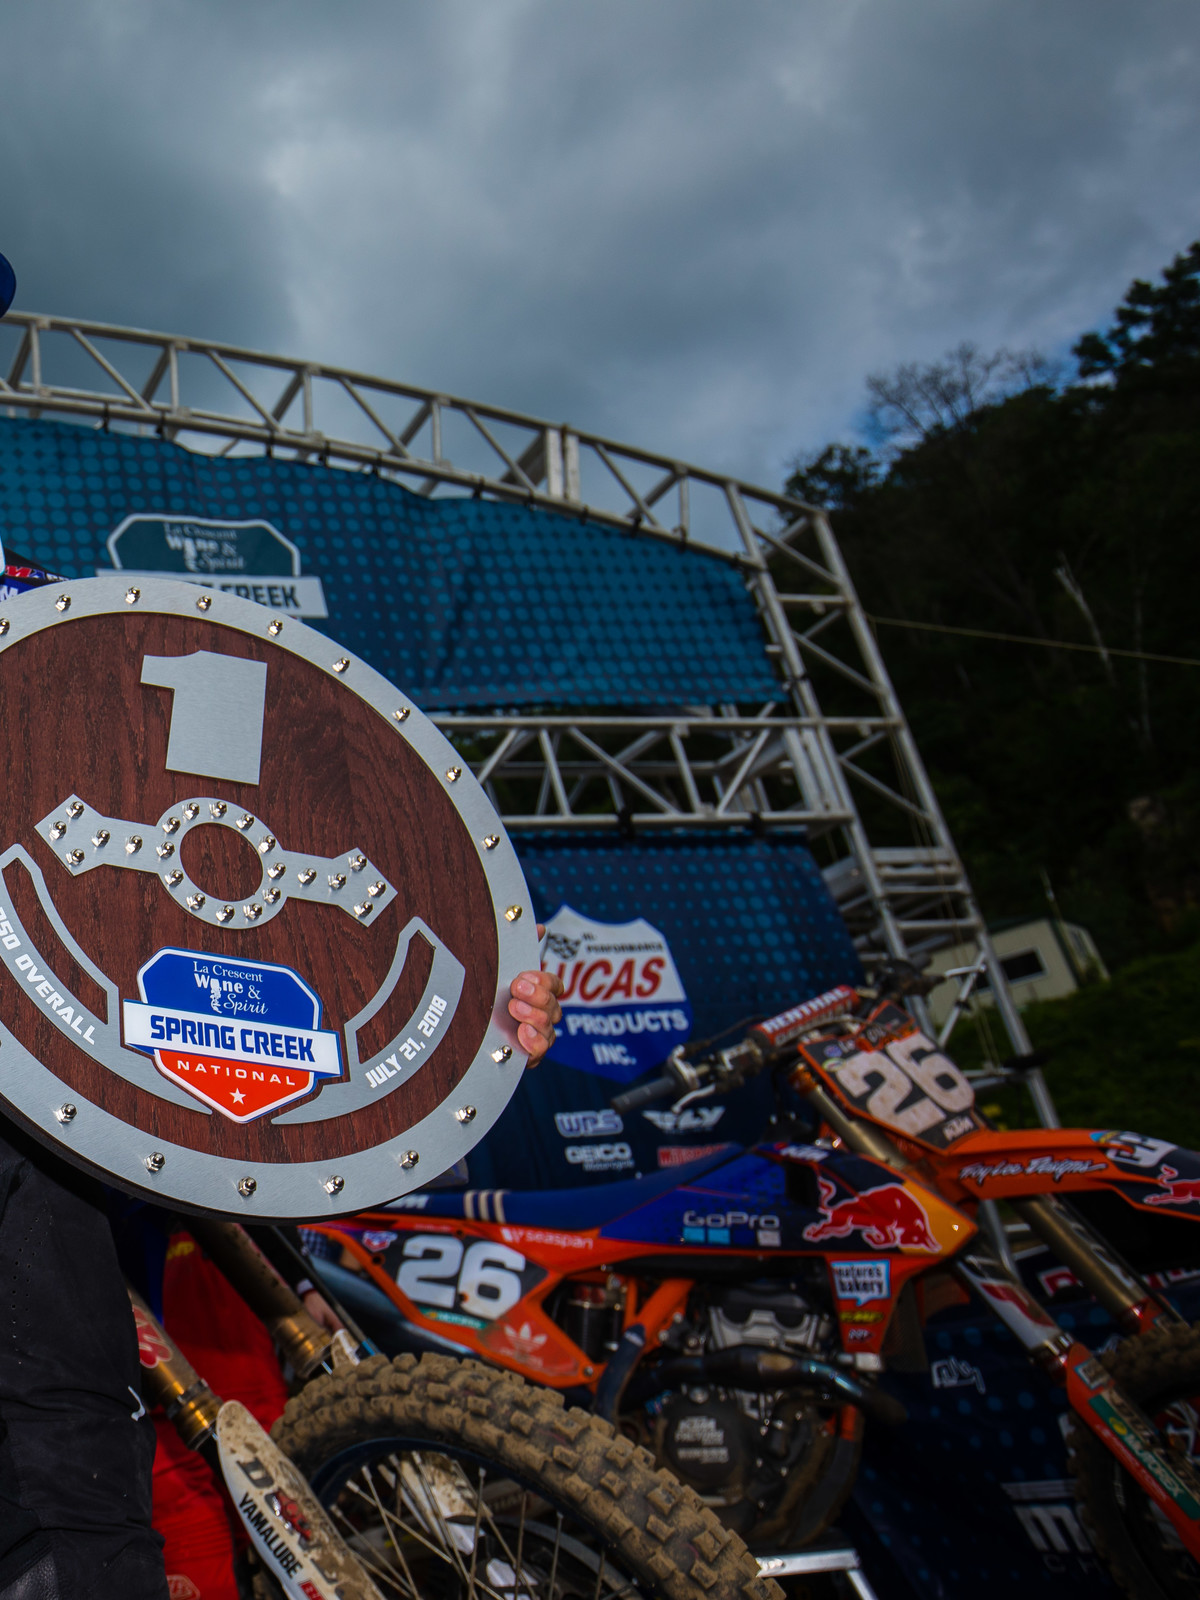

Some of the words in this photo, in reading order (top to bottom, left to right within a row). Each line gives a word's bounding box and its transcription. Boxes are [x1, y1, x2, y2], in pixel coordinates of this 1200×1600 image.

[140, 650, 267, 786] 1
[193, 961, 209, 974] La
[212, 964, 263, 983] Crescent
[541, 958, 665, 1001] UCAS
[15, 954, 96, 1045] OVERALL
[223, 993, 269, 1016] Spirit
[248, 985, 262, 1000] &
[565, 1008, 690, 1036] PRODUCTS
[761, 986, 851, 1034] RENTHAL
[150, 1014, 236, 1051] SPRING
[240, 1028, 316, 1063] CREEK
[365, 1053, 402, 1089] JULY
[398, 1037, 426, 1061] 21,
[417, 994, 448, 1038] 2018
[592, 1042, 638, 1065] INC.
[177, 1059, 296, 1087] NATIONAL
[835, 1032, 975, 1136] 26
[554, 1109, 624, 1138] WPS
[565, 1142, 632, 1164] GEICO
[683, 1210, 780, 1229] GoPro
[525, 1228, 594, 1250] seaspan
[396, 1234, 526, 1321] 26
[239, 1492, 303, 1580] YAMALUBE
